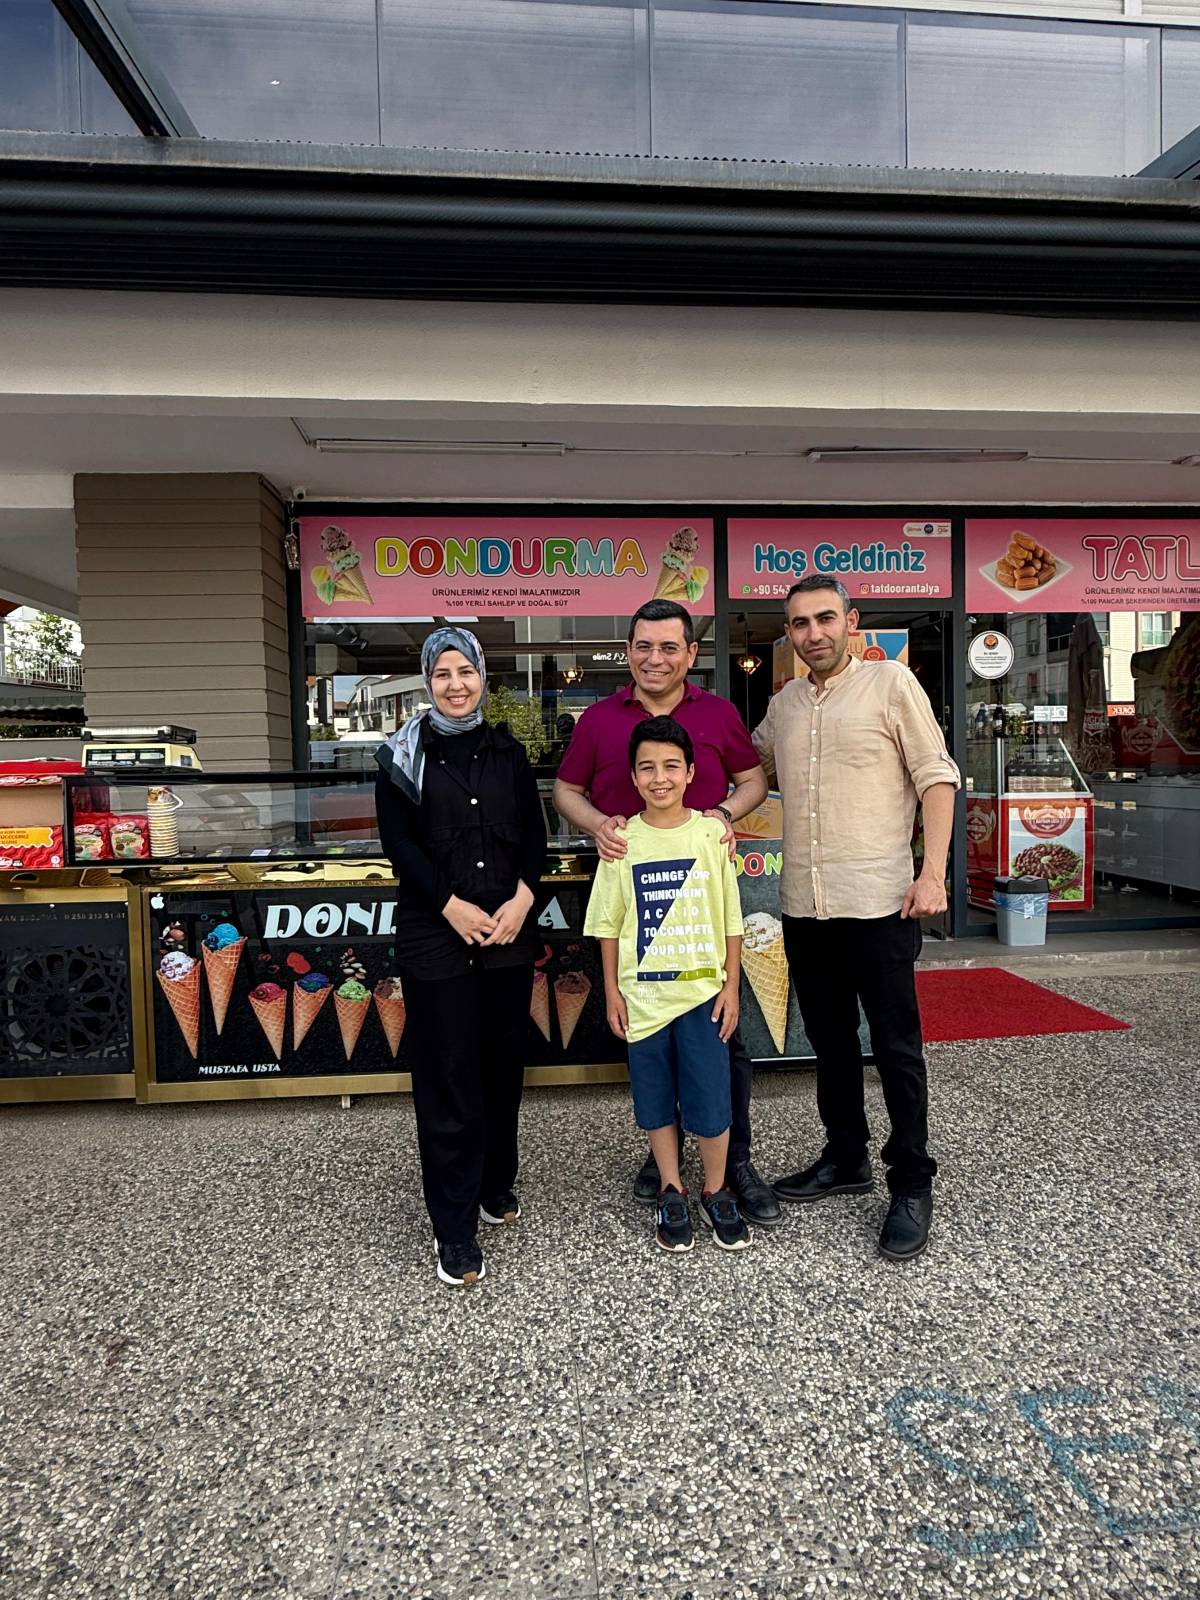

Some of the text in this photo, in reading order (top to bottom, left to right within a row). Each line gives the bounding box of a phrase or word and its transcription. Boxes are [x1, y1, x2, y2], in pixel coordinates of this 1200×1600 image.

[375, 536, 648, 578] DONDURMA
[755, 542, 926, 578] Hoş Geldiniz
[432, 588, 580, 597] ÜRÜNLERİMİZ KENDİ İMALATIMIZDIR
[753, 585, 770, 595] +90
[871, 583, 940, 596] tatdoorantalya
[1085, 586, 1136, 595] ÜRÜNLERİMİZ
[1137, 586, 1160, 595] KENDİ
[528, 599, 553, 607] DOĞAL
[555, 599, 568, 607] SÜT
[641, 870, 685, 885] CHANGE
[642, 887, 689, 902] THINKING
[643, 927, 658, 938] TO
[643, 944, 675, 956] YOUR
[198, 1063, 281, 1074] MUSTAFA USTA
